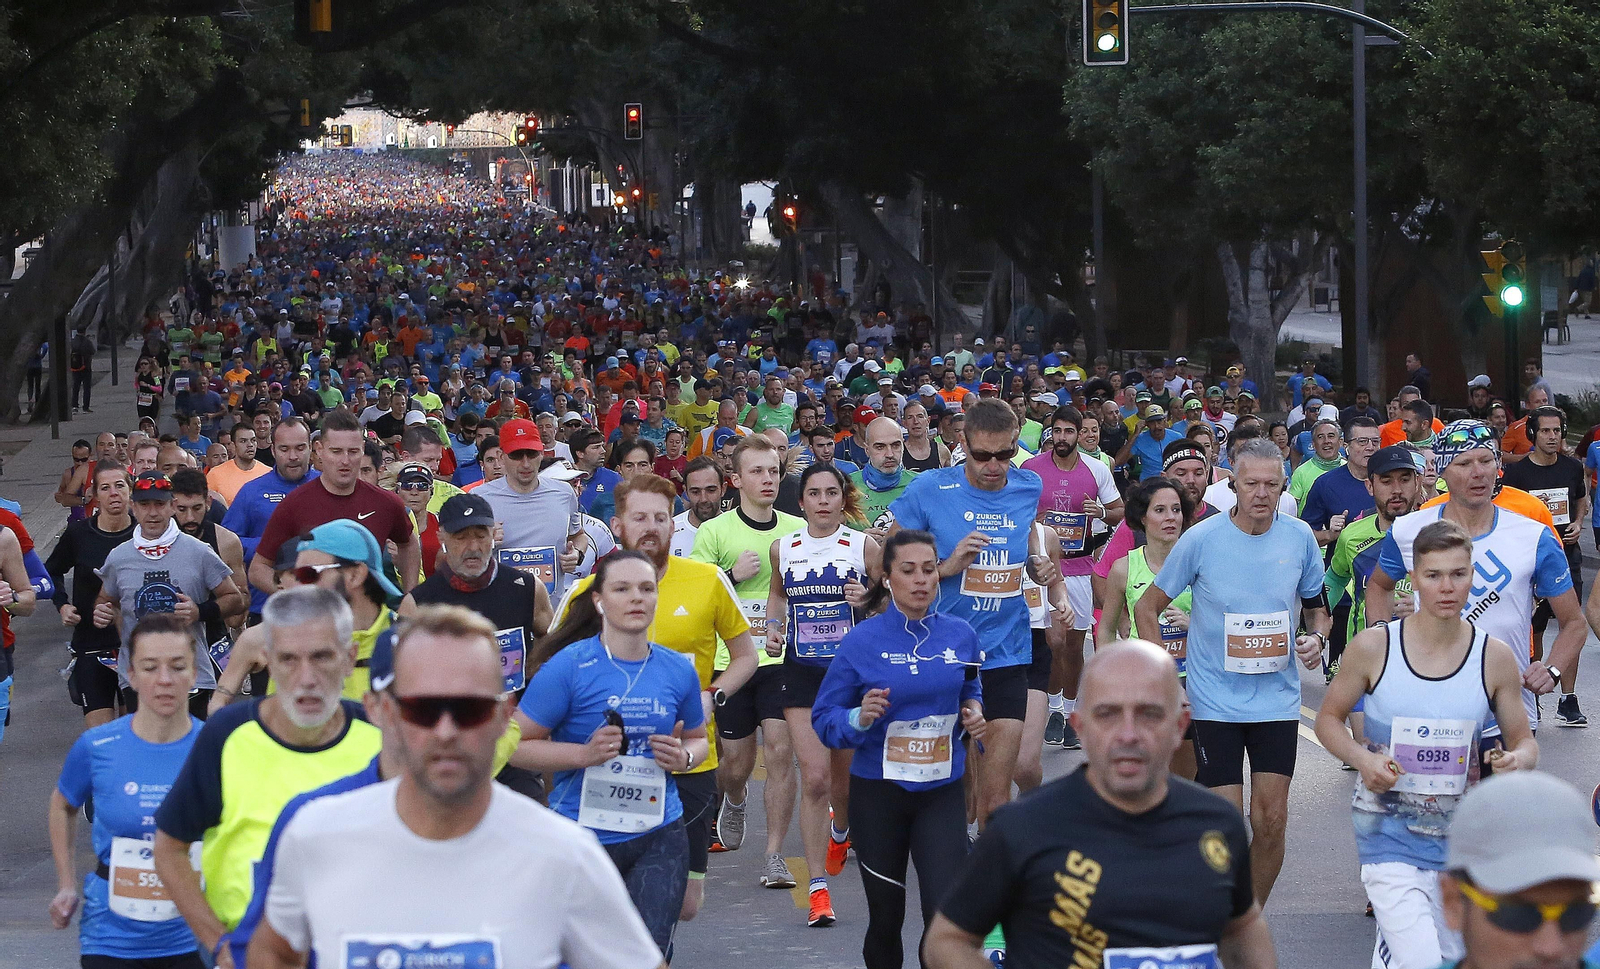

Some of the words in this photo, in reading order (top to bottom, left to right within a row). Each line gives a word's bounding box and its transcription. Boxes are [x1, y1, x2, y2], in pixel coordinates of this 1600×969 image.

[984, 572, 1011, 583] 6057
[1256, 619, 1282, 627] ZURICH
[812, 623, 837, 635] 2630
[1245, 637, 1272, 649] 5975
[1433, 728, 1464, 737] ZURICH
[1416, 749, 1450, 763] 6938
[625, 764, 655, 775] ZURICH
[609, 785, 642, 801] 7092
